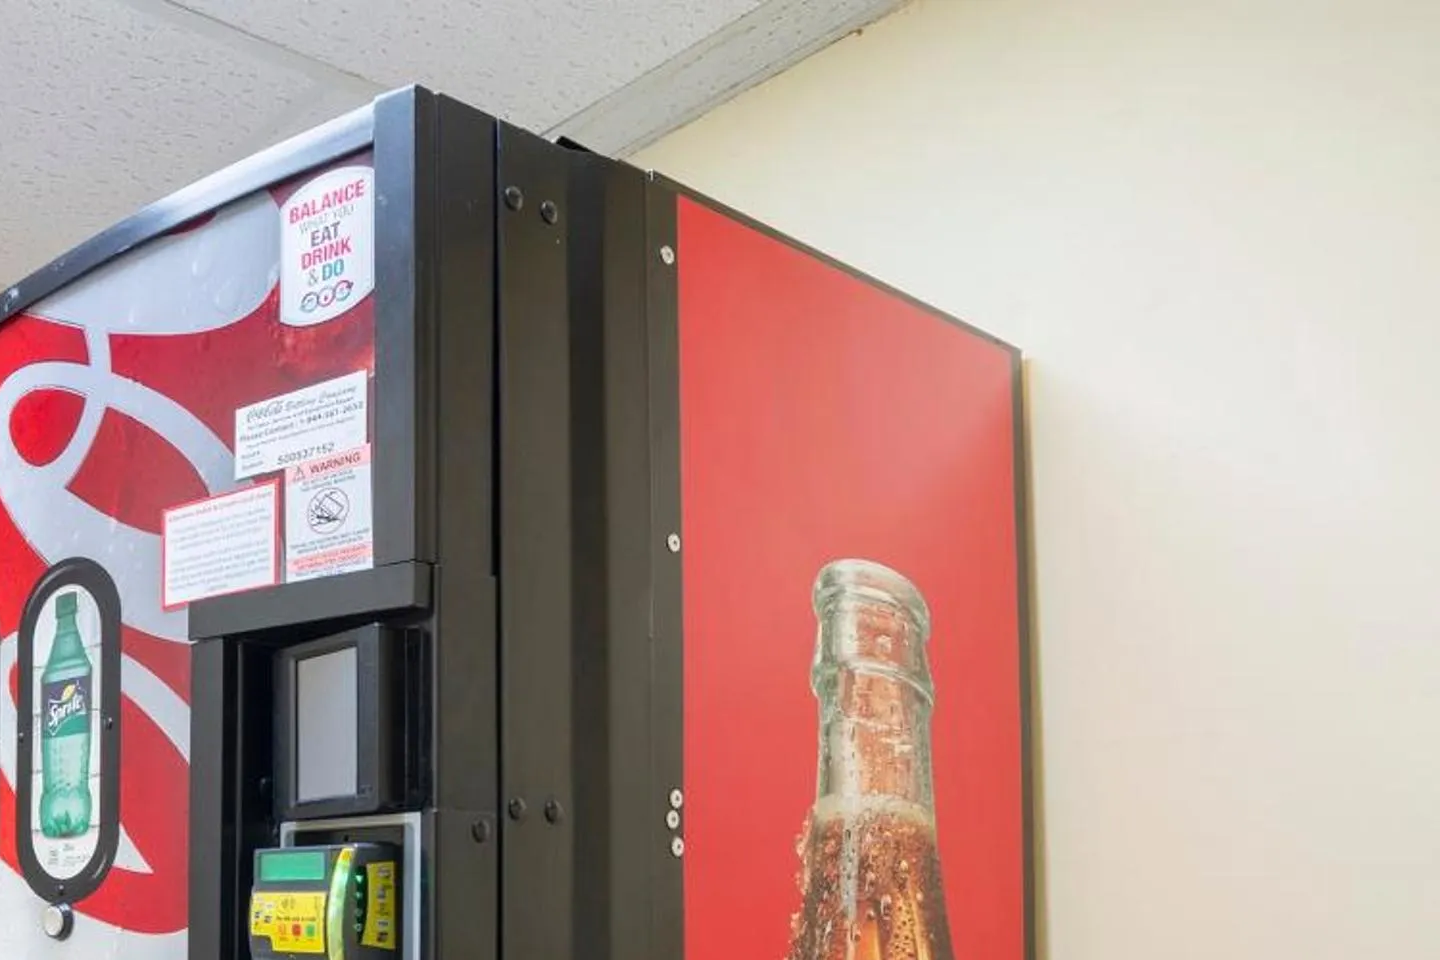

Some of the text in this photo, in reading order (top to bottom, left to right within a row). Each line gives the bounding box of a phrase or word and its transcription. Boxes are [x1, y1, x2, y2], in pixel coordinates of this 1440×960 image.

[289, 180, 365, 224] BALANCE
[311, 222, 340, 247] EAT
[301, 236, 351, 270] DRINK
[322, 259, 344, 281] DO
[310, 451, 361, 474] WARNING
